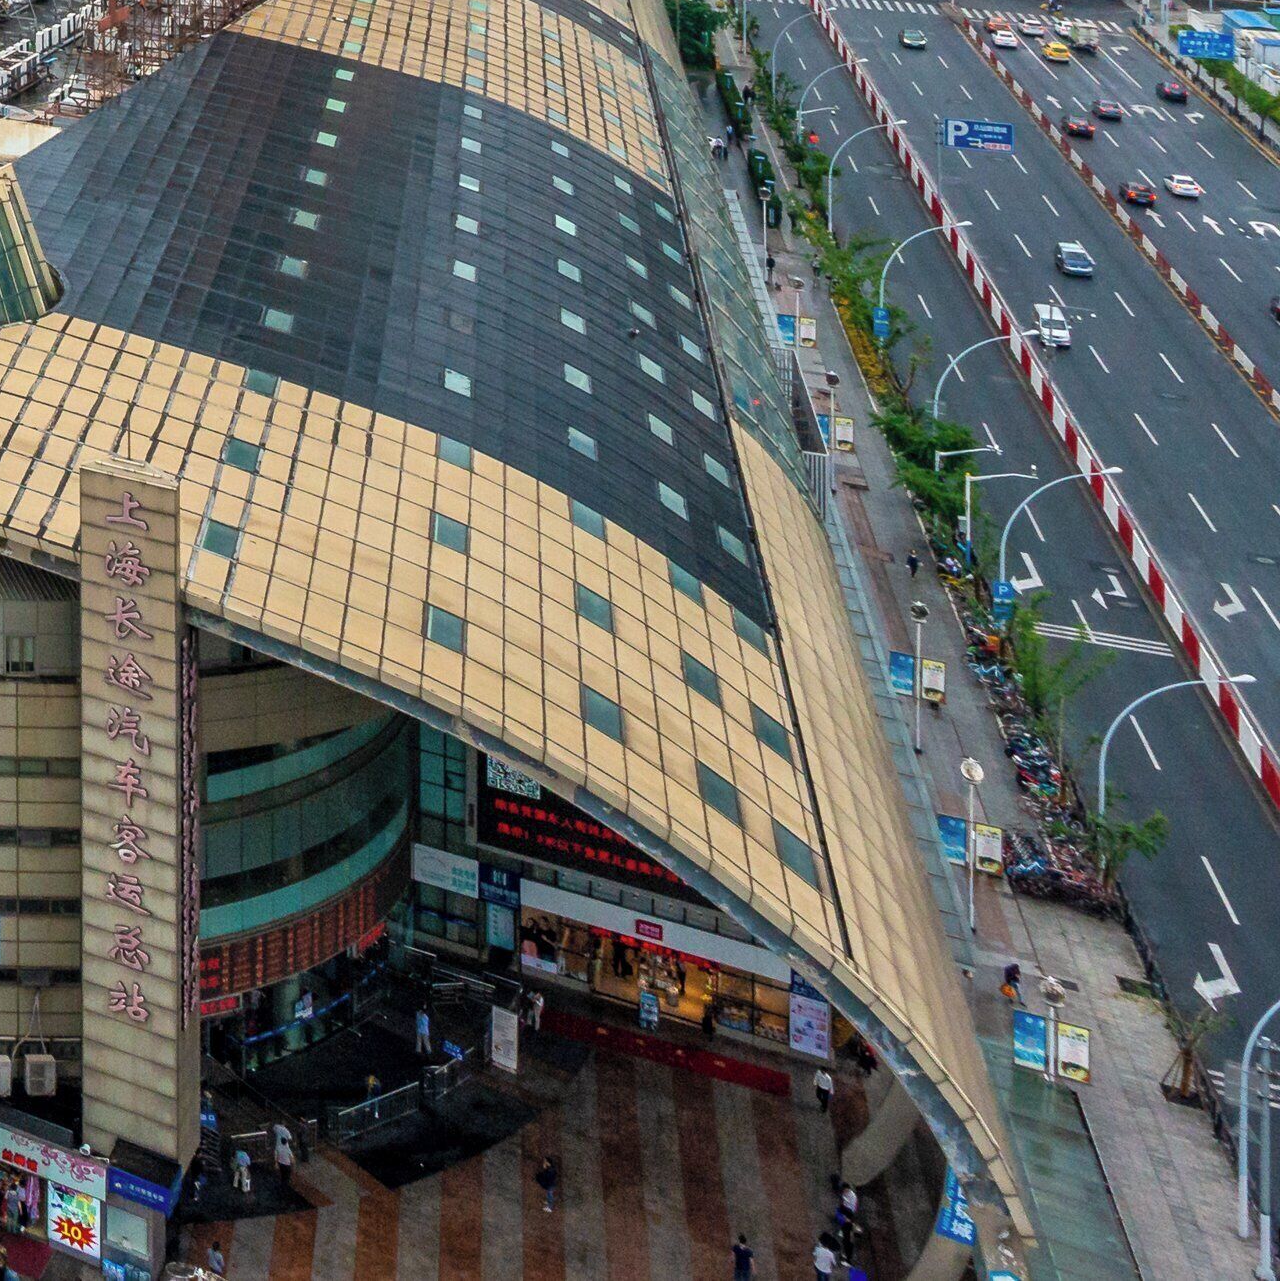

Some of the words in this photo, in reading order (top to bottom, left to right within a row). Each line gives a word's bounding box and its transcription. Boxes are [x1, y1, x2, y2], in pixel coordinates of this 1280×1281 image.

[947, 120, 969, 146] P
[104, 491, 153, 1023] 上海长途汽车客运总站
[61, 1222, 82, 1240] 10
